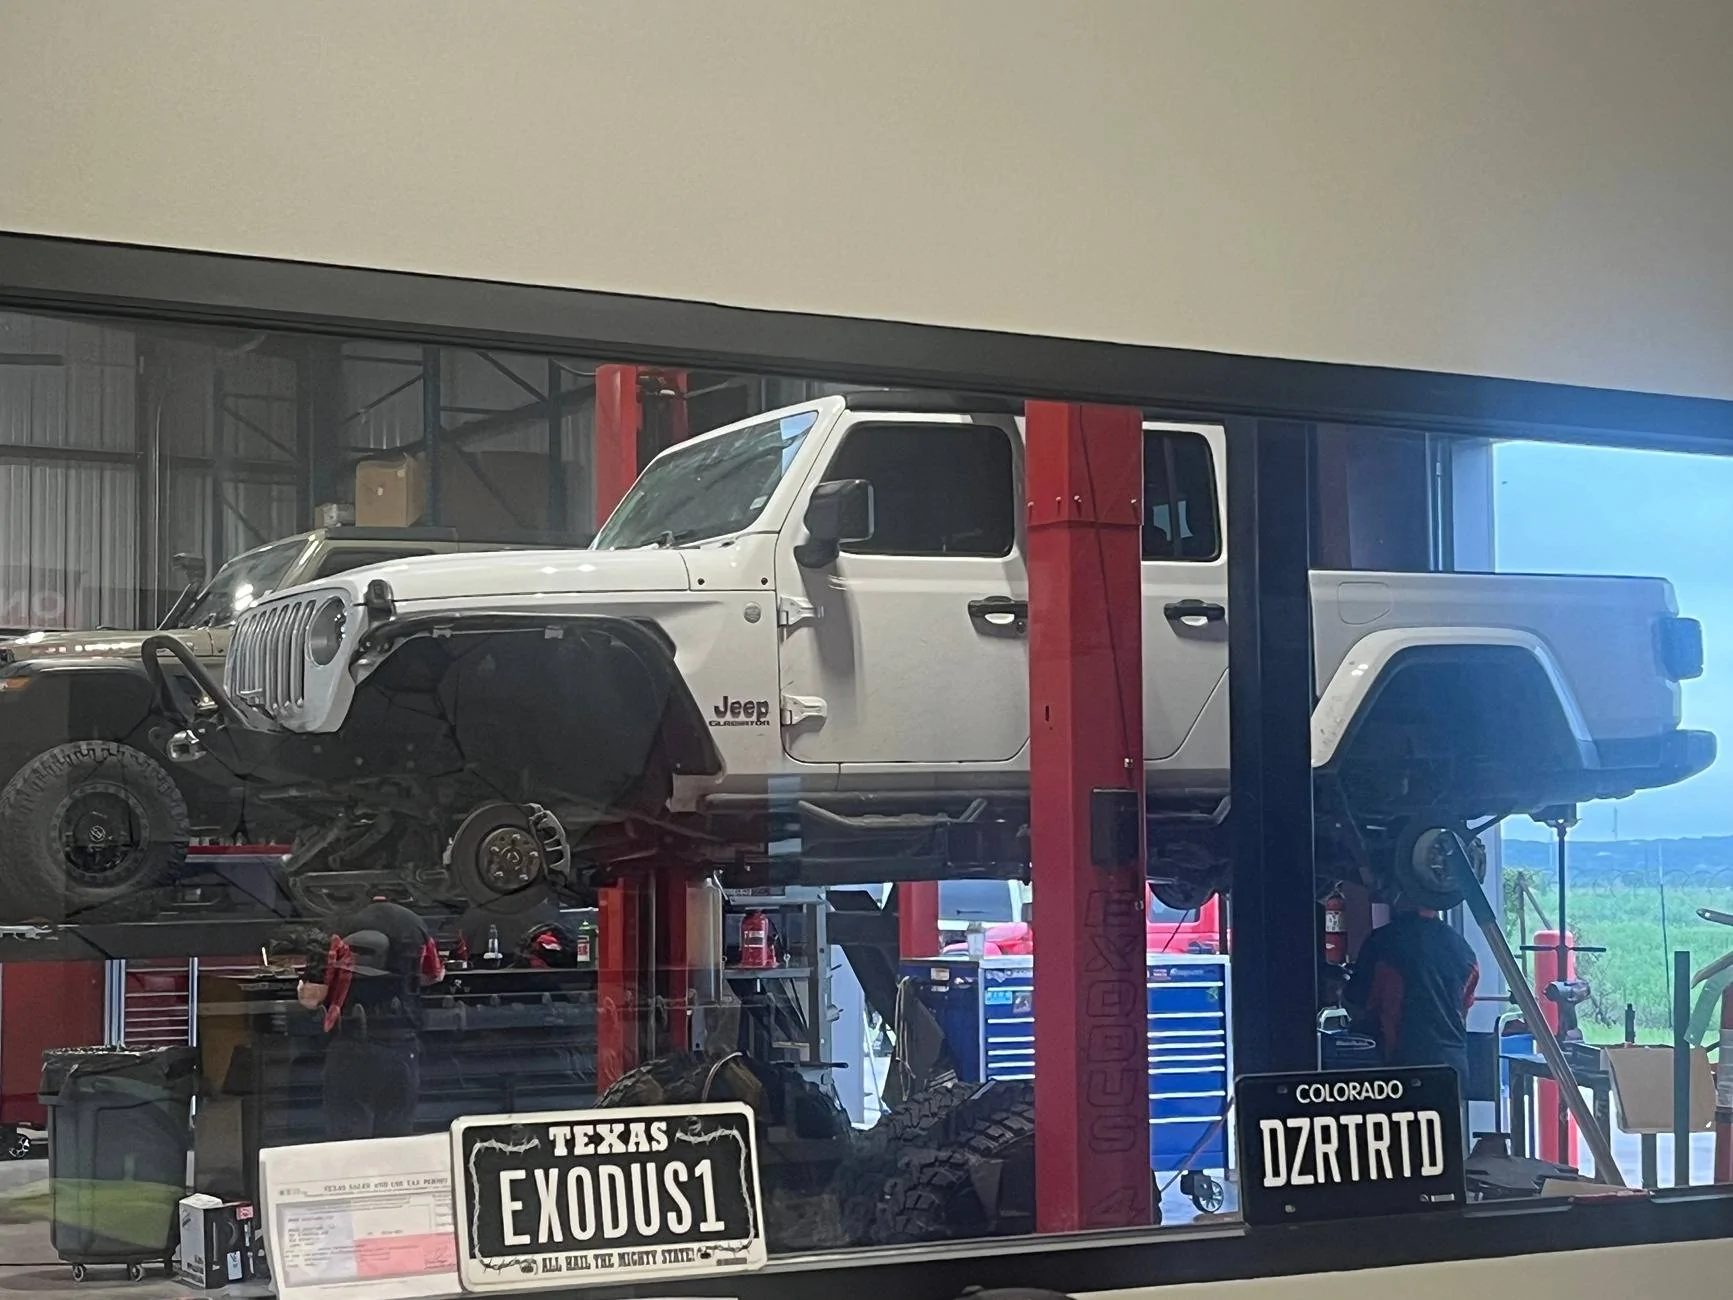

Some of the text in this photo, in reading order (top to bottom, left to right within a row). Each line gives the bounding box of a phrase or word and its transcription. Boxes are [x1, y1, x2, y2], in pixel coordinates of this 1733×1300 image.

[713, 696, 770, 721] Jeep
[1083, 888, 1138, 1153] EXODUS
[1296, 1080, 1403, 1103] COLORADO
[548, 1121, 669, 1157] TEXAS
[1259, 1110, 1444, 1188] DZRTRTD
[499, 1159, 726, 1246] EXODUS1
[541, 1247, 696, 1273] ALL HAIL THE MIGHTY STATE!
